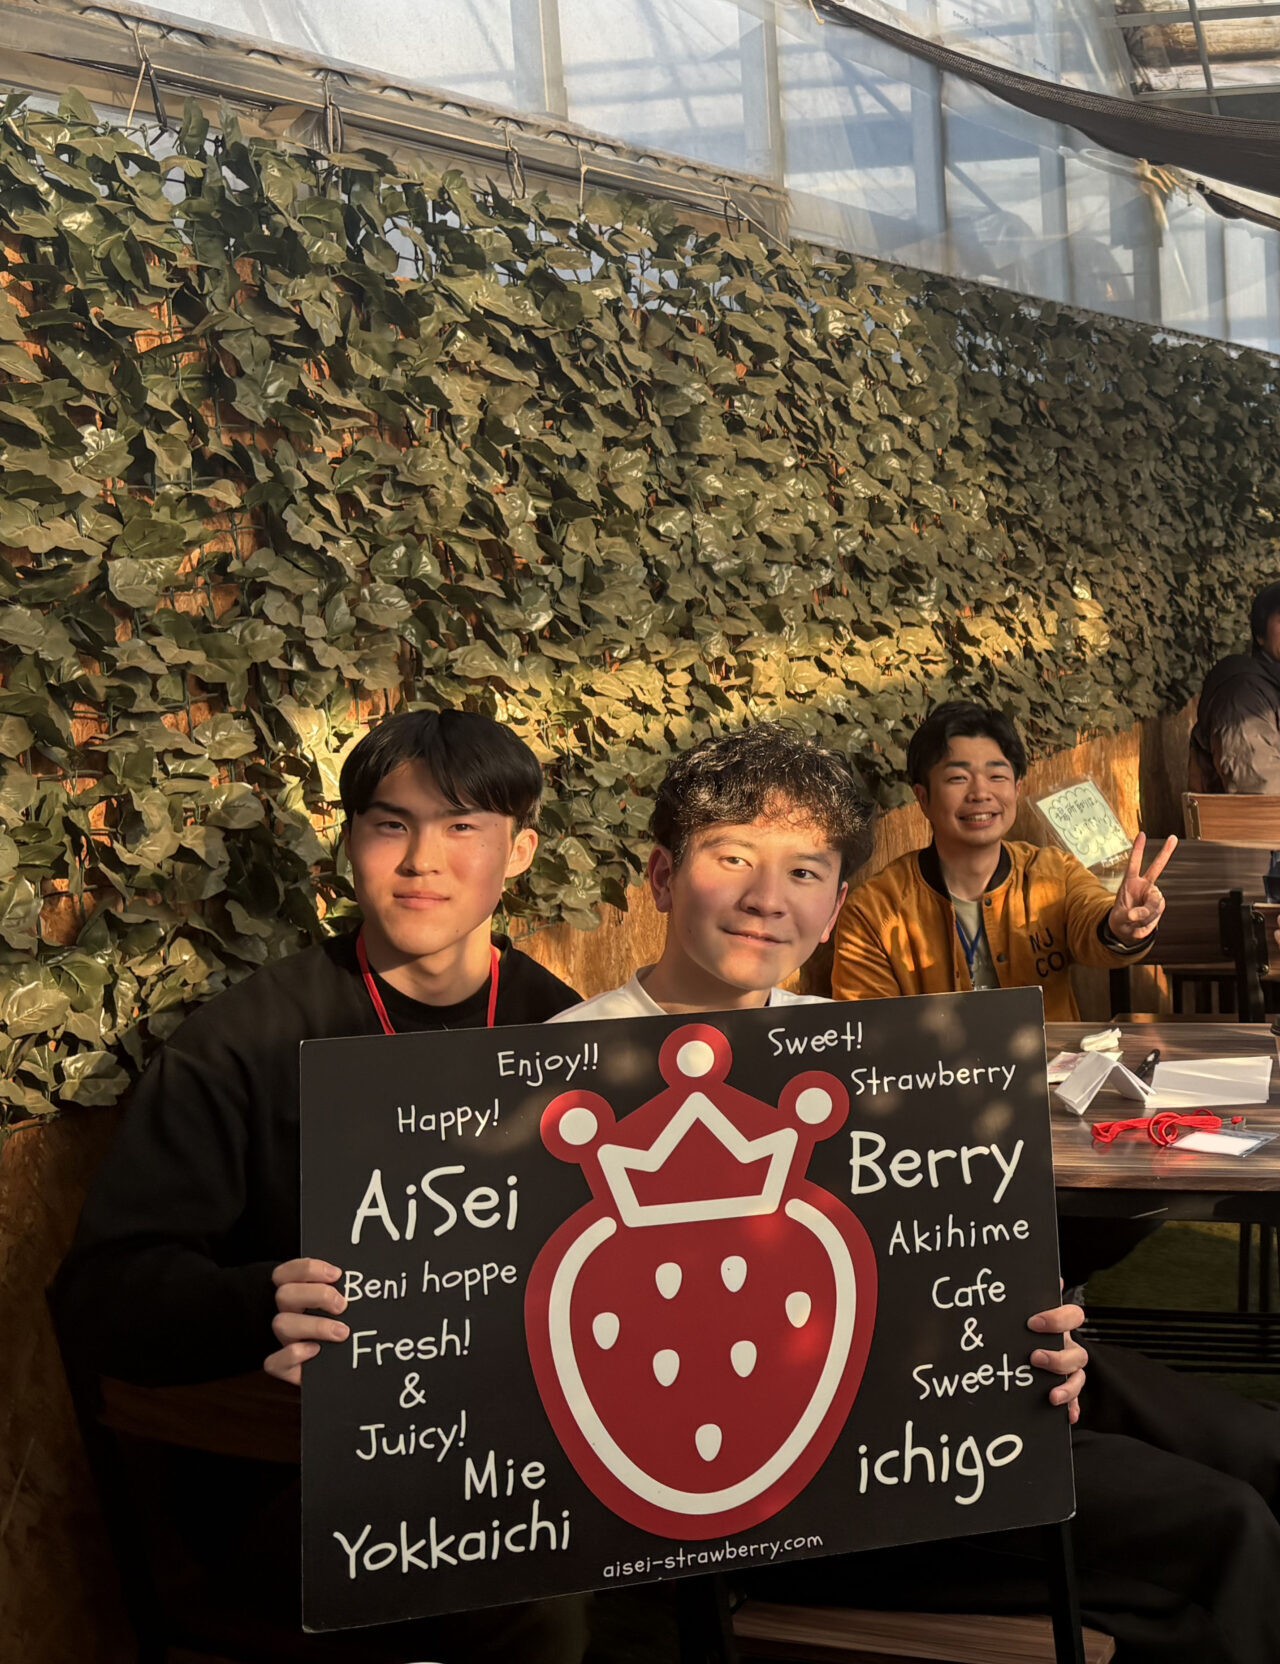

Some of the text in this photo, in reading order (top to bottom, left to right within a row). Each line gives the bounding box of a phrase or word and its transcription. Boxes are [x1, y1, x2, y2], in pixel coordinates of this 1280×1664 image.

[1035, 951, 1065, 978] CO
[767, 1021, 863, 1057] Sweet!
[497, 1042, 599, 1087] Enjoy!!
[850, 1060, 1016, 1096] Strawberry
[397, 1098, 499, 1141] Happy!
[849, 1130, 1025, 1204] Berry
[350, 1164, 518, 1245] AiSei
[888, 1214, 1030, 1256] Akihime
[343, 1260, 517, 1302] Beni hoppe
[931, 1267, 1007, 1309] Cafe
[351, 1318, 471, 1369] Fresh!
[960, 1317, 984, 1352] &
[399, 1371, 427, 1409] &
[912, 1354, 1033, 1400] Sweets
[355, 1411, 467, 1462] Juicy!
[464, 1450, 546, 1500] Mie
[858, 1420, 1024, 1505] ichigo
[332, 1499, 570, 1579] Yokkaichi
[603, 1535, 823, 1578] aisei-strawberry.com
